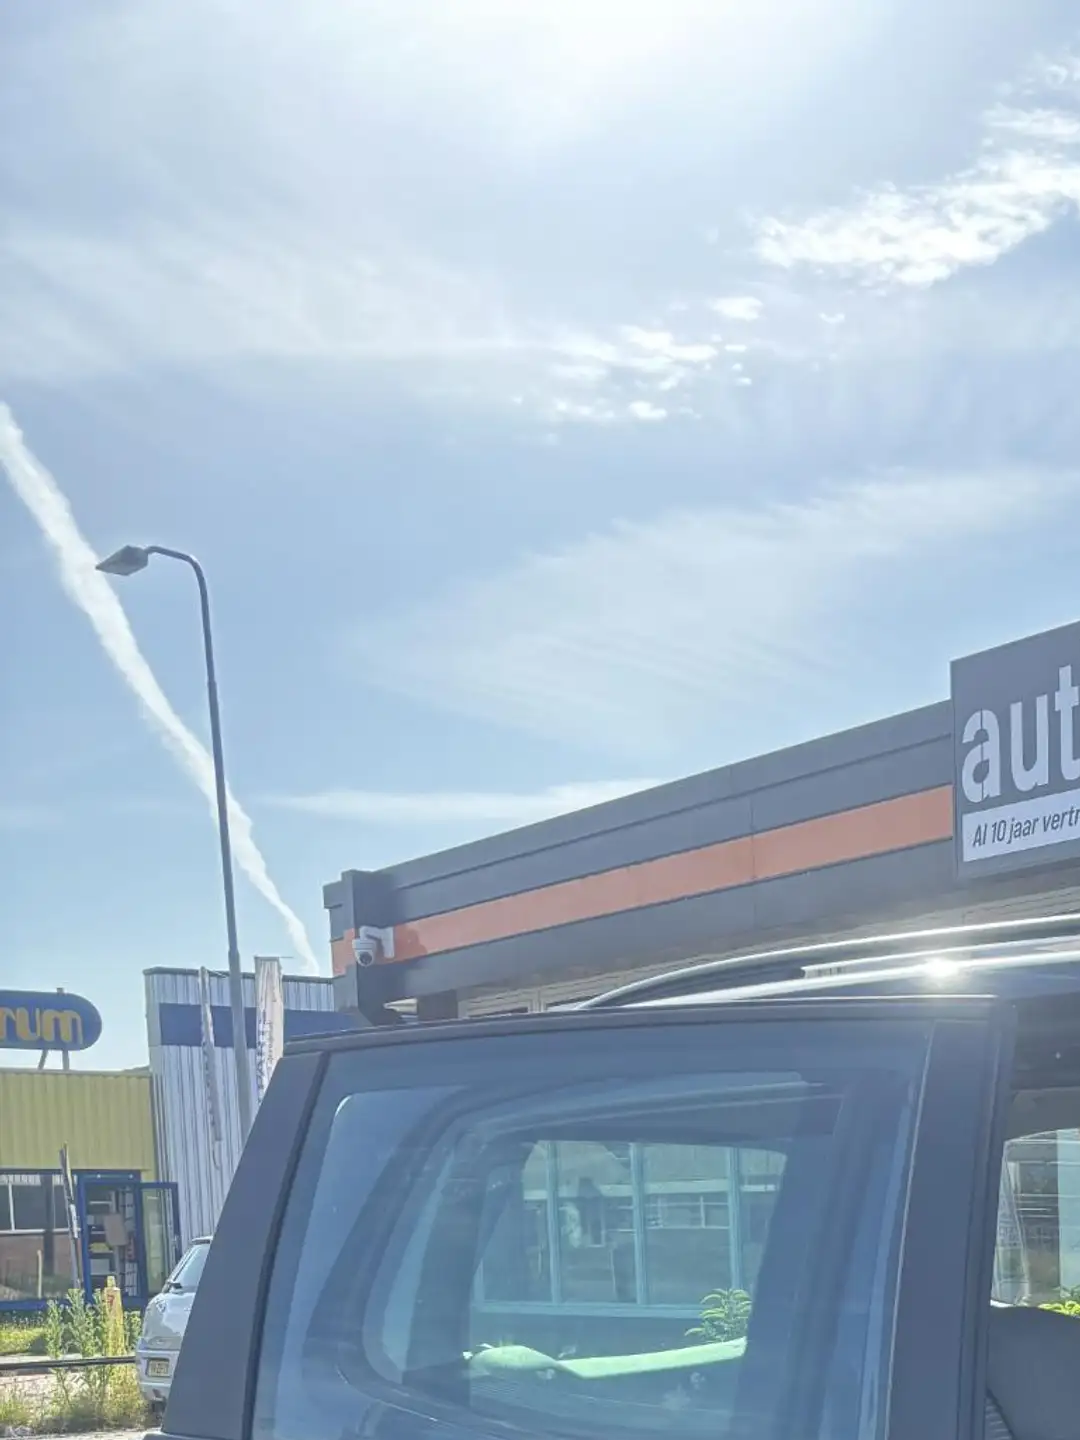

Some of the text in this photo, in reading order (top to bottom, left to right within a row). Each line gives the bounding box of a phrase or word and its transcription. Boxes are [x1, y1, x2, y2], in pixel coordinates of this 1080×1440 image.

[972, 826, 988, 847] Al
[991, 818, 1006, 845] 10
[1006, 816, 1040, 844] jaar
